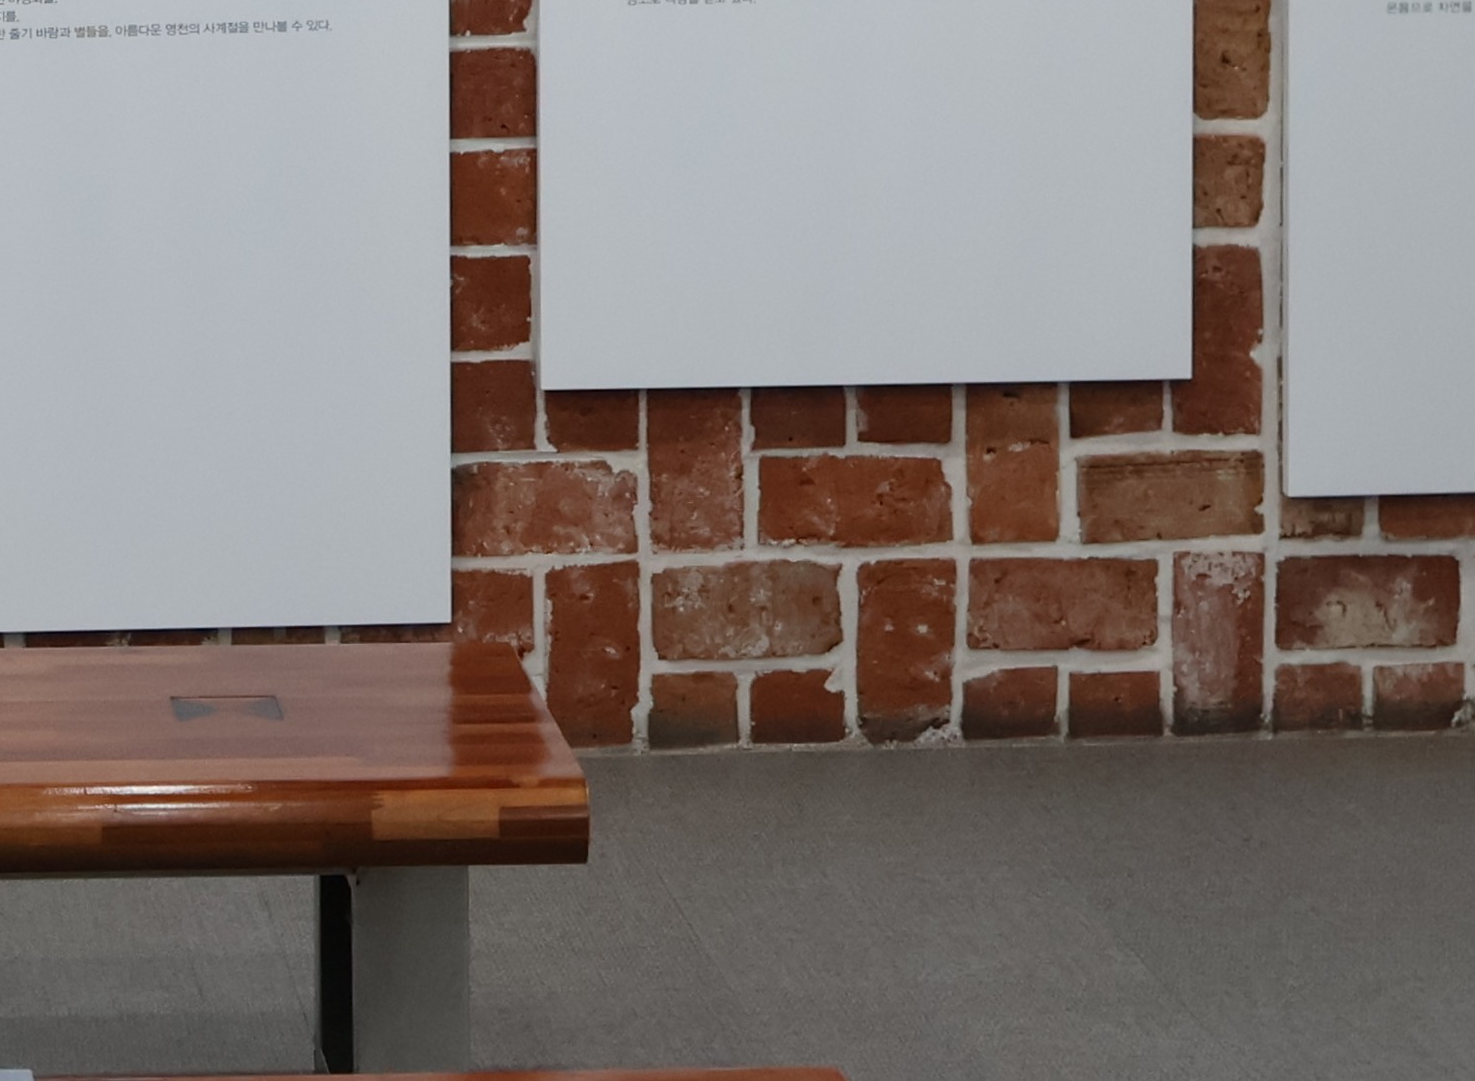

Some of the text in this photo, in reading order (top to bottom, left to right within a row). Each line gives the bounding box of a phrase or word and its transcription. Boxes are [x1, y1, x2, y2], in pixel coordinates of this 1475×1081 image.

[35, 26, 71, 40] 바람과
[114, 23, 162, 37] 아름다운
[164, 22, 201, 37] 영천의
[291, 19, 303, 33] 수
